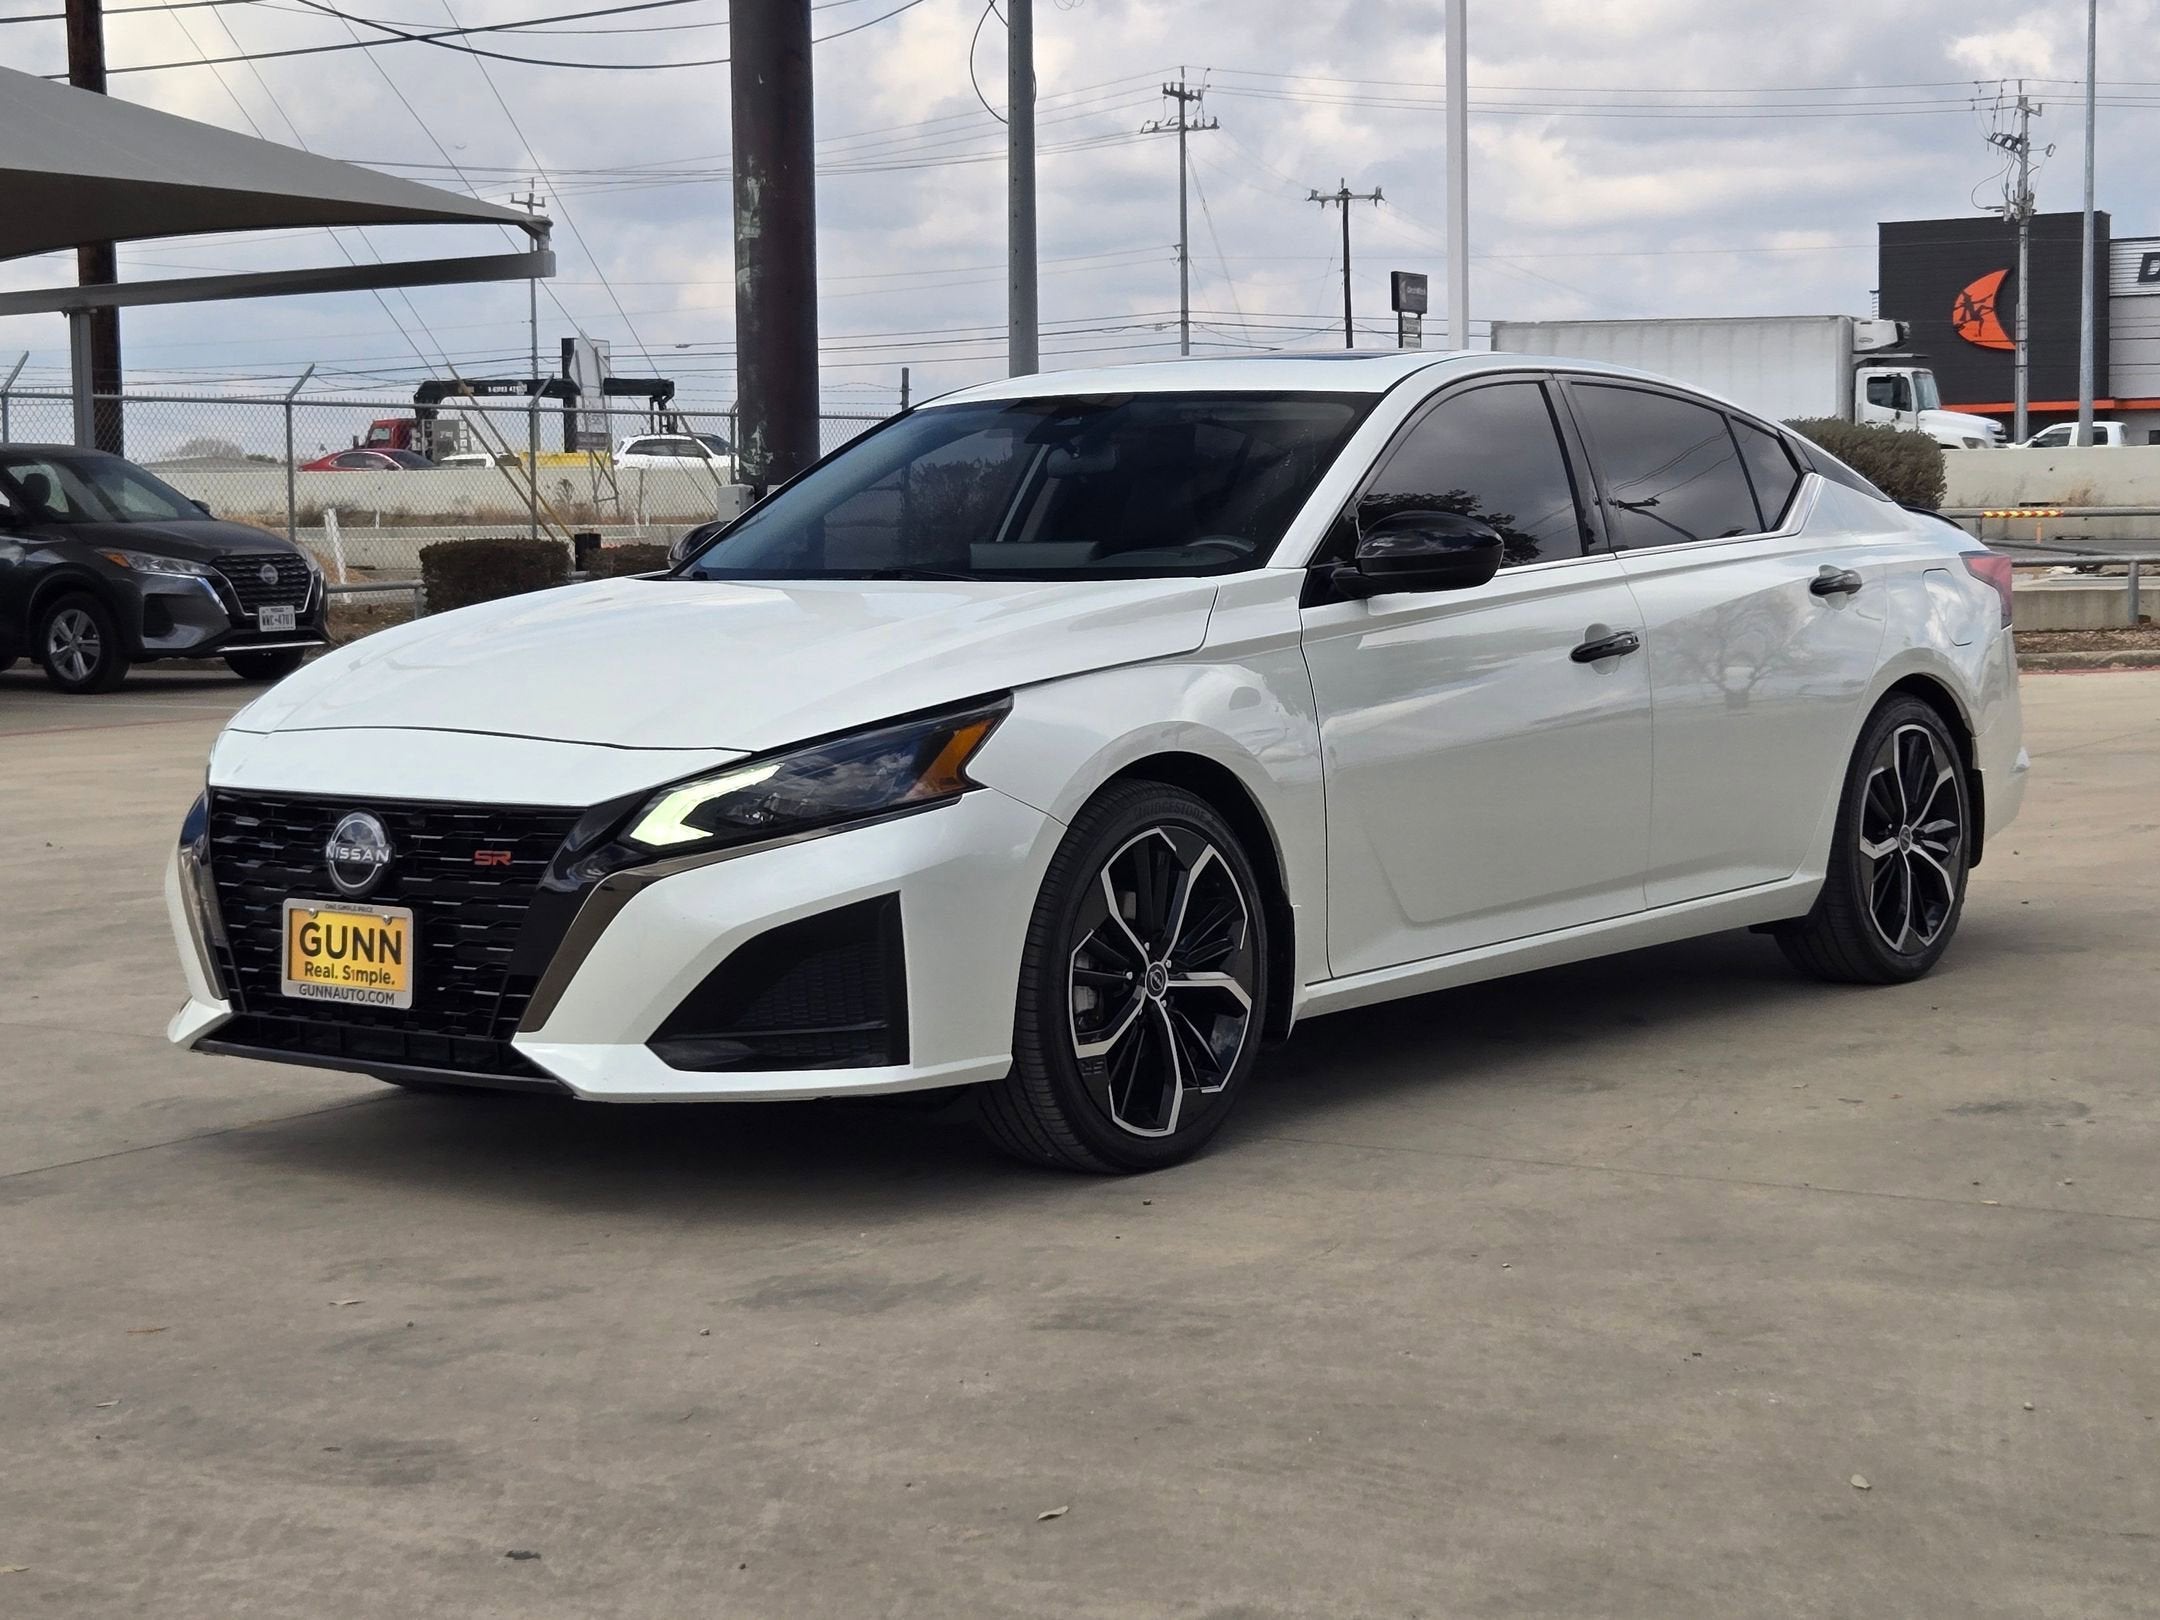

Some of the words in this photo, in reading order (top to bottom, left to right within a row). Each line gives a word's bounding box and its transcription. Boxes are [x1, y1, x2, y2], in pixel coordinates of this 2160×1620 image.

[326, 846, 390, 863] NISSAN
[474, 850, 512, 866] SR
[299, 921, 402, 965] GUNN
[304, 960, 338, 980] Real.
[299, 983, 395, 1006] GUNNAUTO.COM
